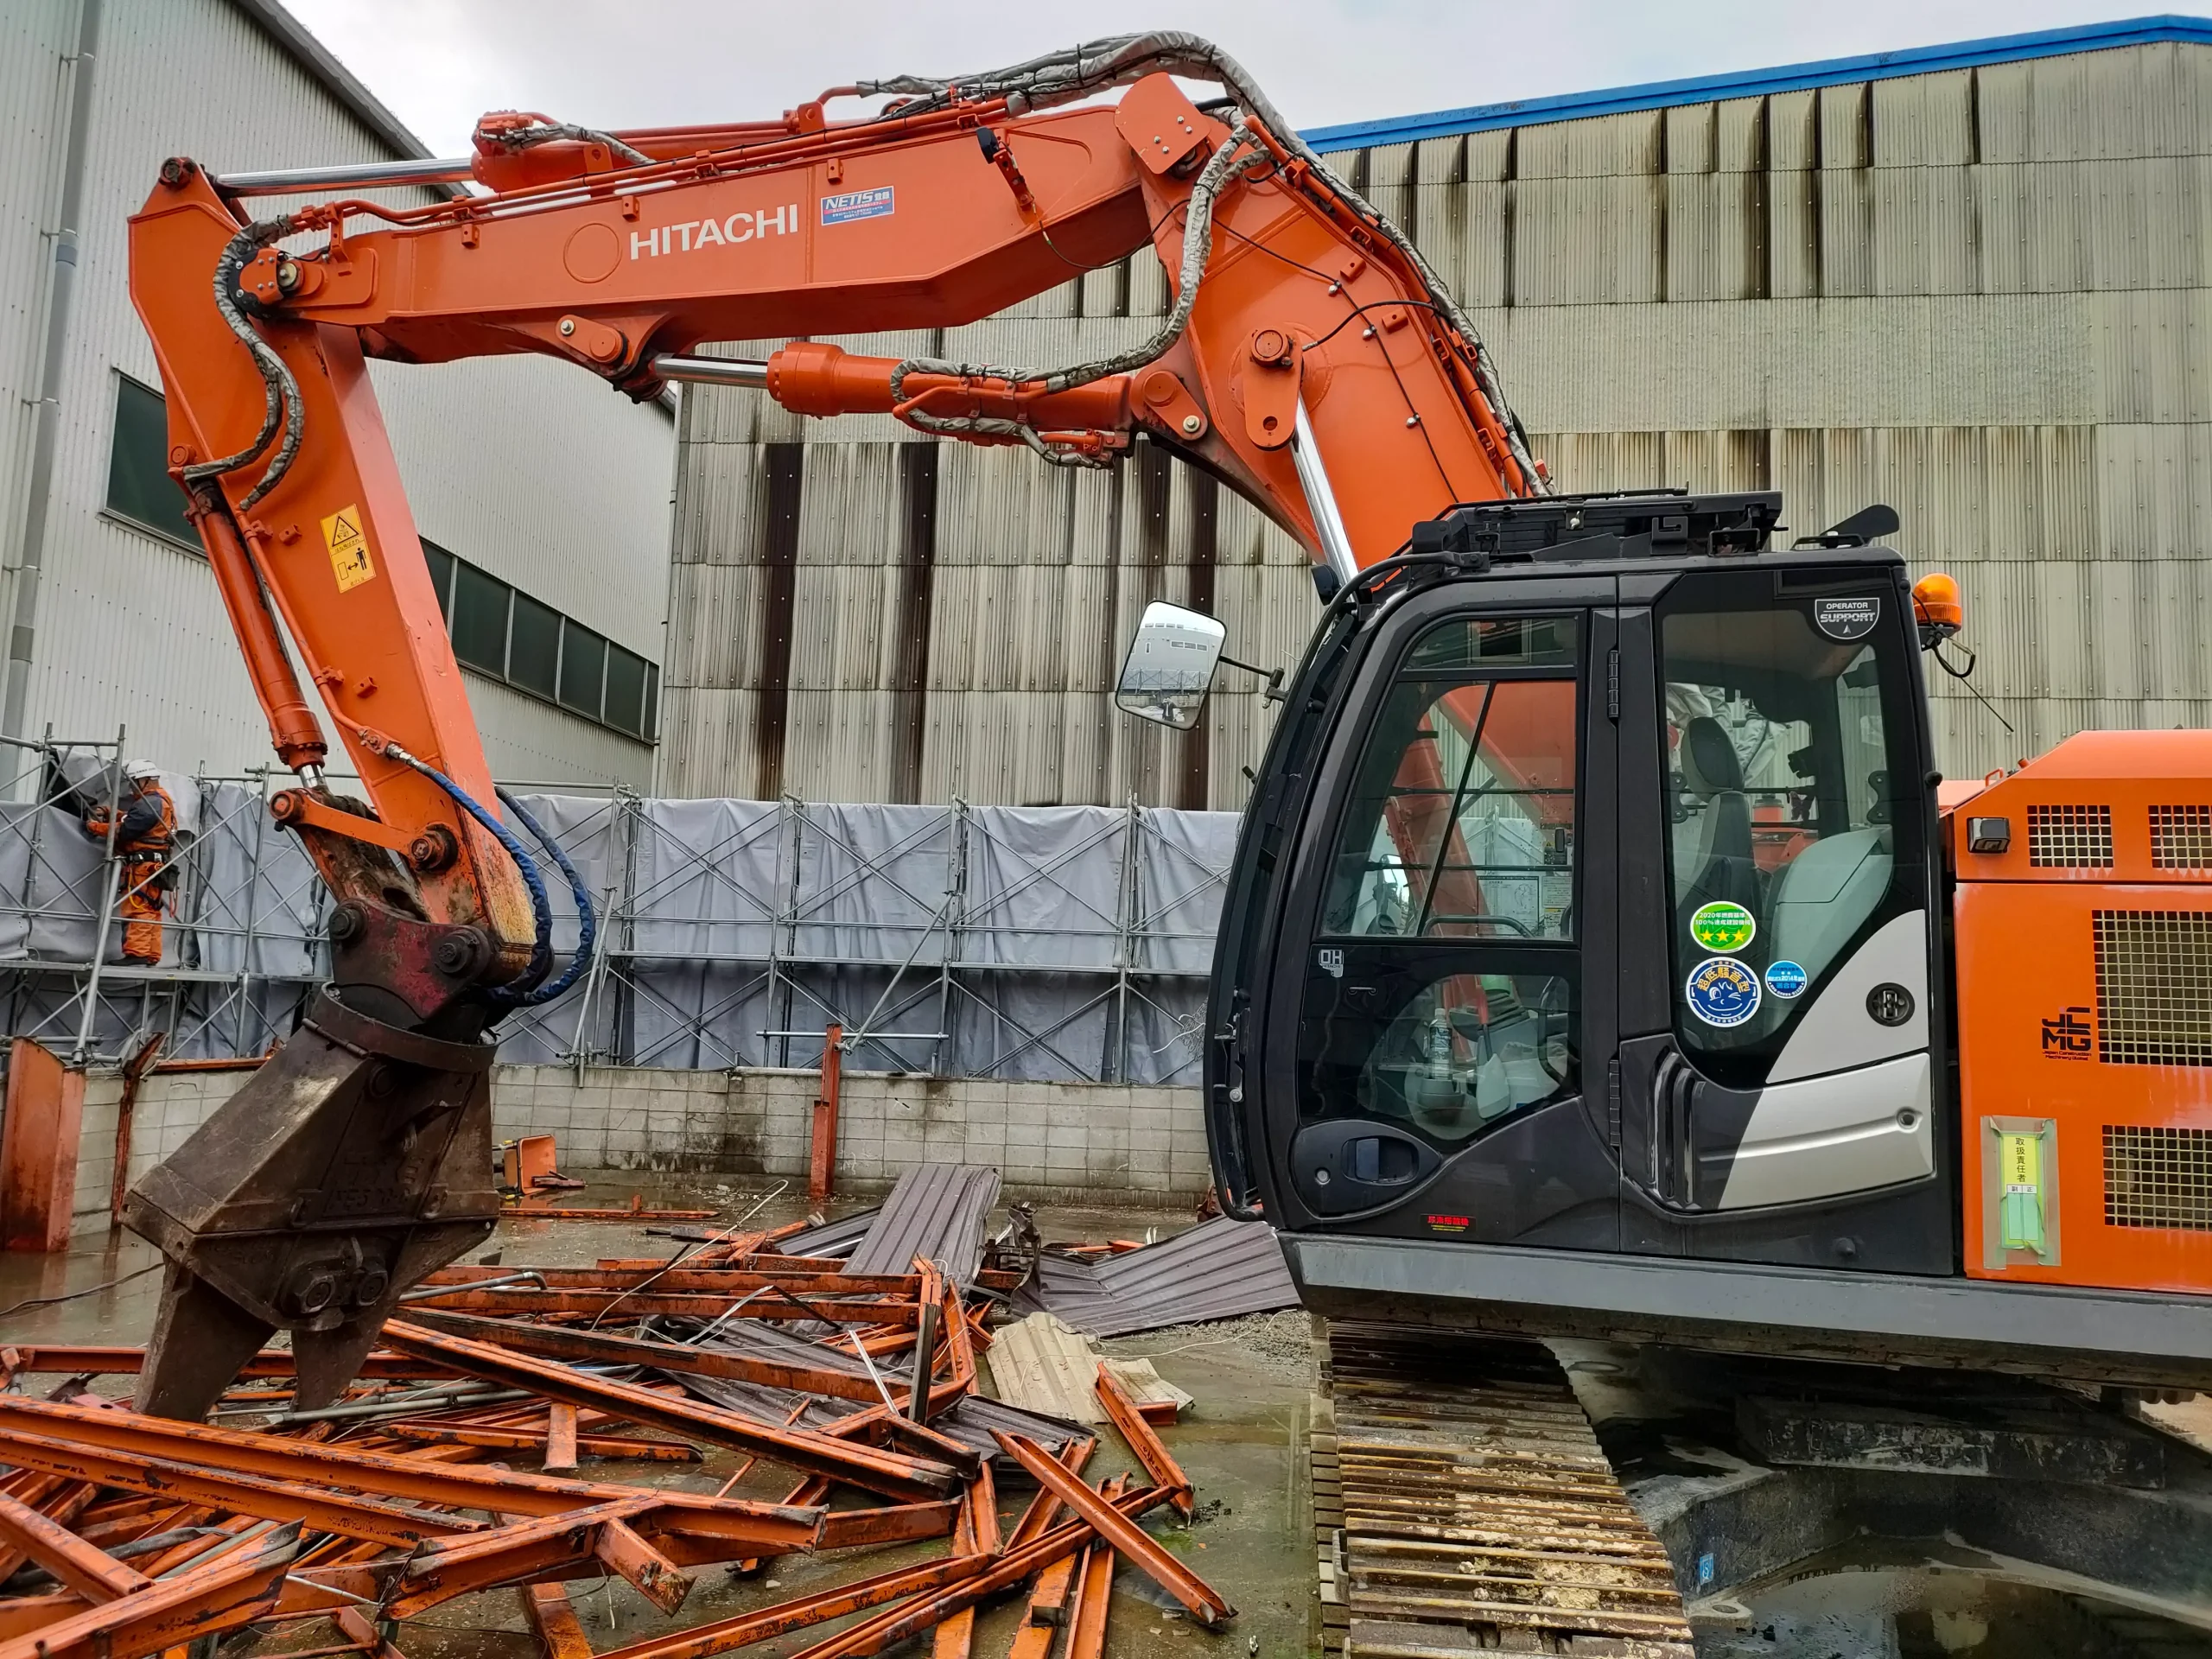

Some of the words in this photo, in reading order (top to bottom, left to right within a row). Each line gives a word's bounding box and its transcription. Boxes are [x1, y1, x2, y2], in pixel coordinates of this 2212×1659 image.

[630, 203, 798, 260] HITACHI
[1820, 612, 1876, 623] SUPPORT
[1697, 966, 1751, 993] 超低騒音型
[2015, 1137, 2026, 1183] 取扱責任者
